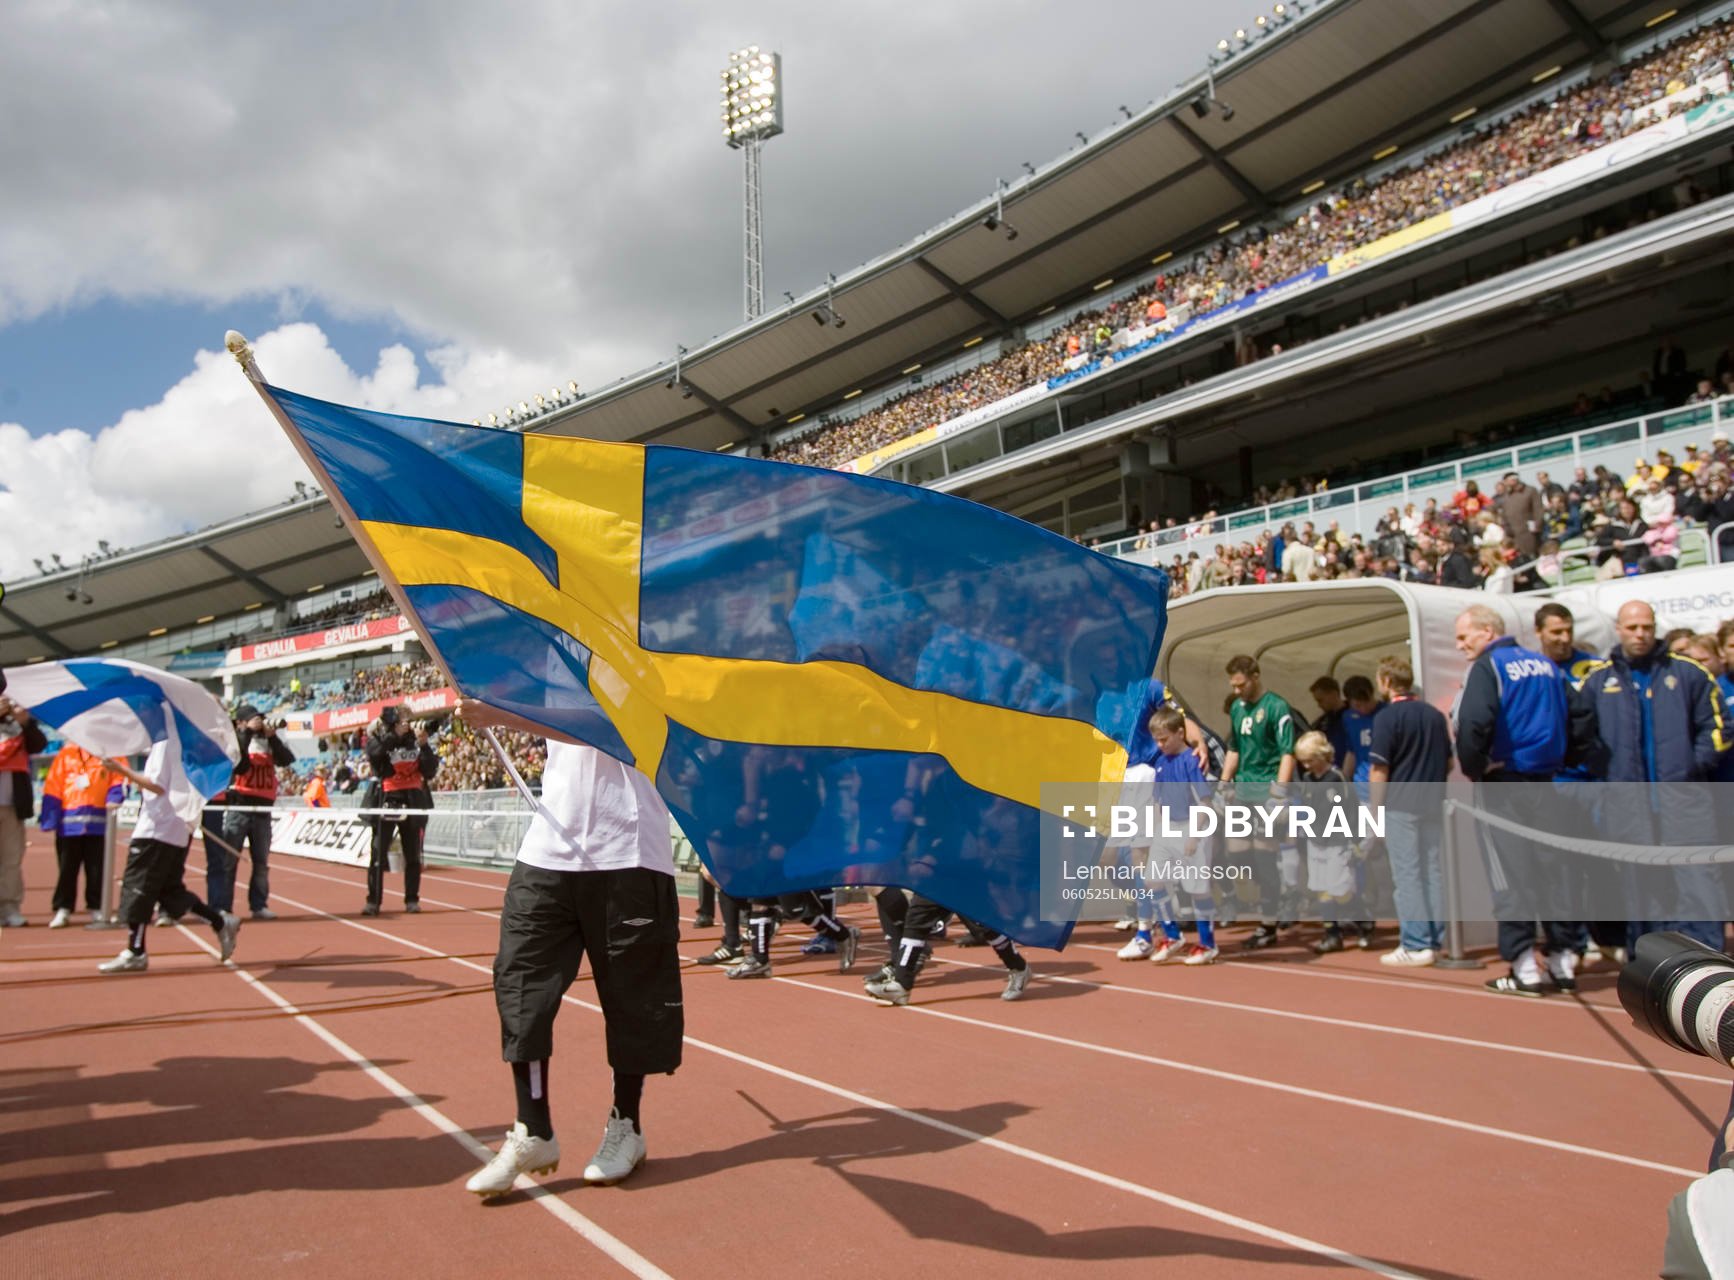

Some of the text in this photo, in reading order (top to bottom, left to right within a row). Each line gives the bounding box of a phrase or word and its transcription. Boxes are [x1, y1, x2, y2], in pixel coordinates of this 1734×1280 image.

[324, 623, 369, 646] GEVALIA
[254, 637, 297, 660] GEVALIA
[1505, 658, 1555, 682] SUOMI
